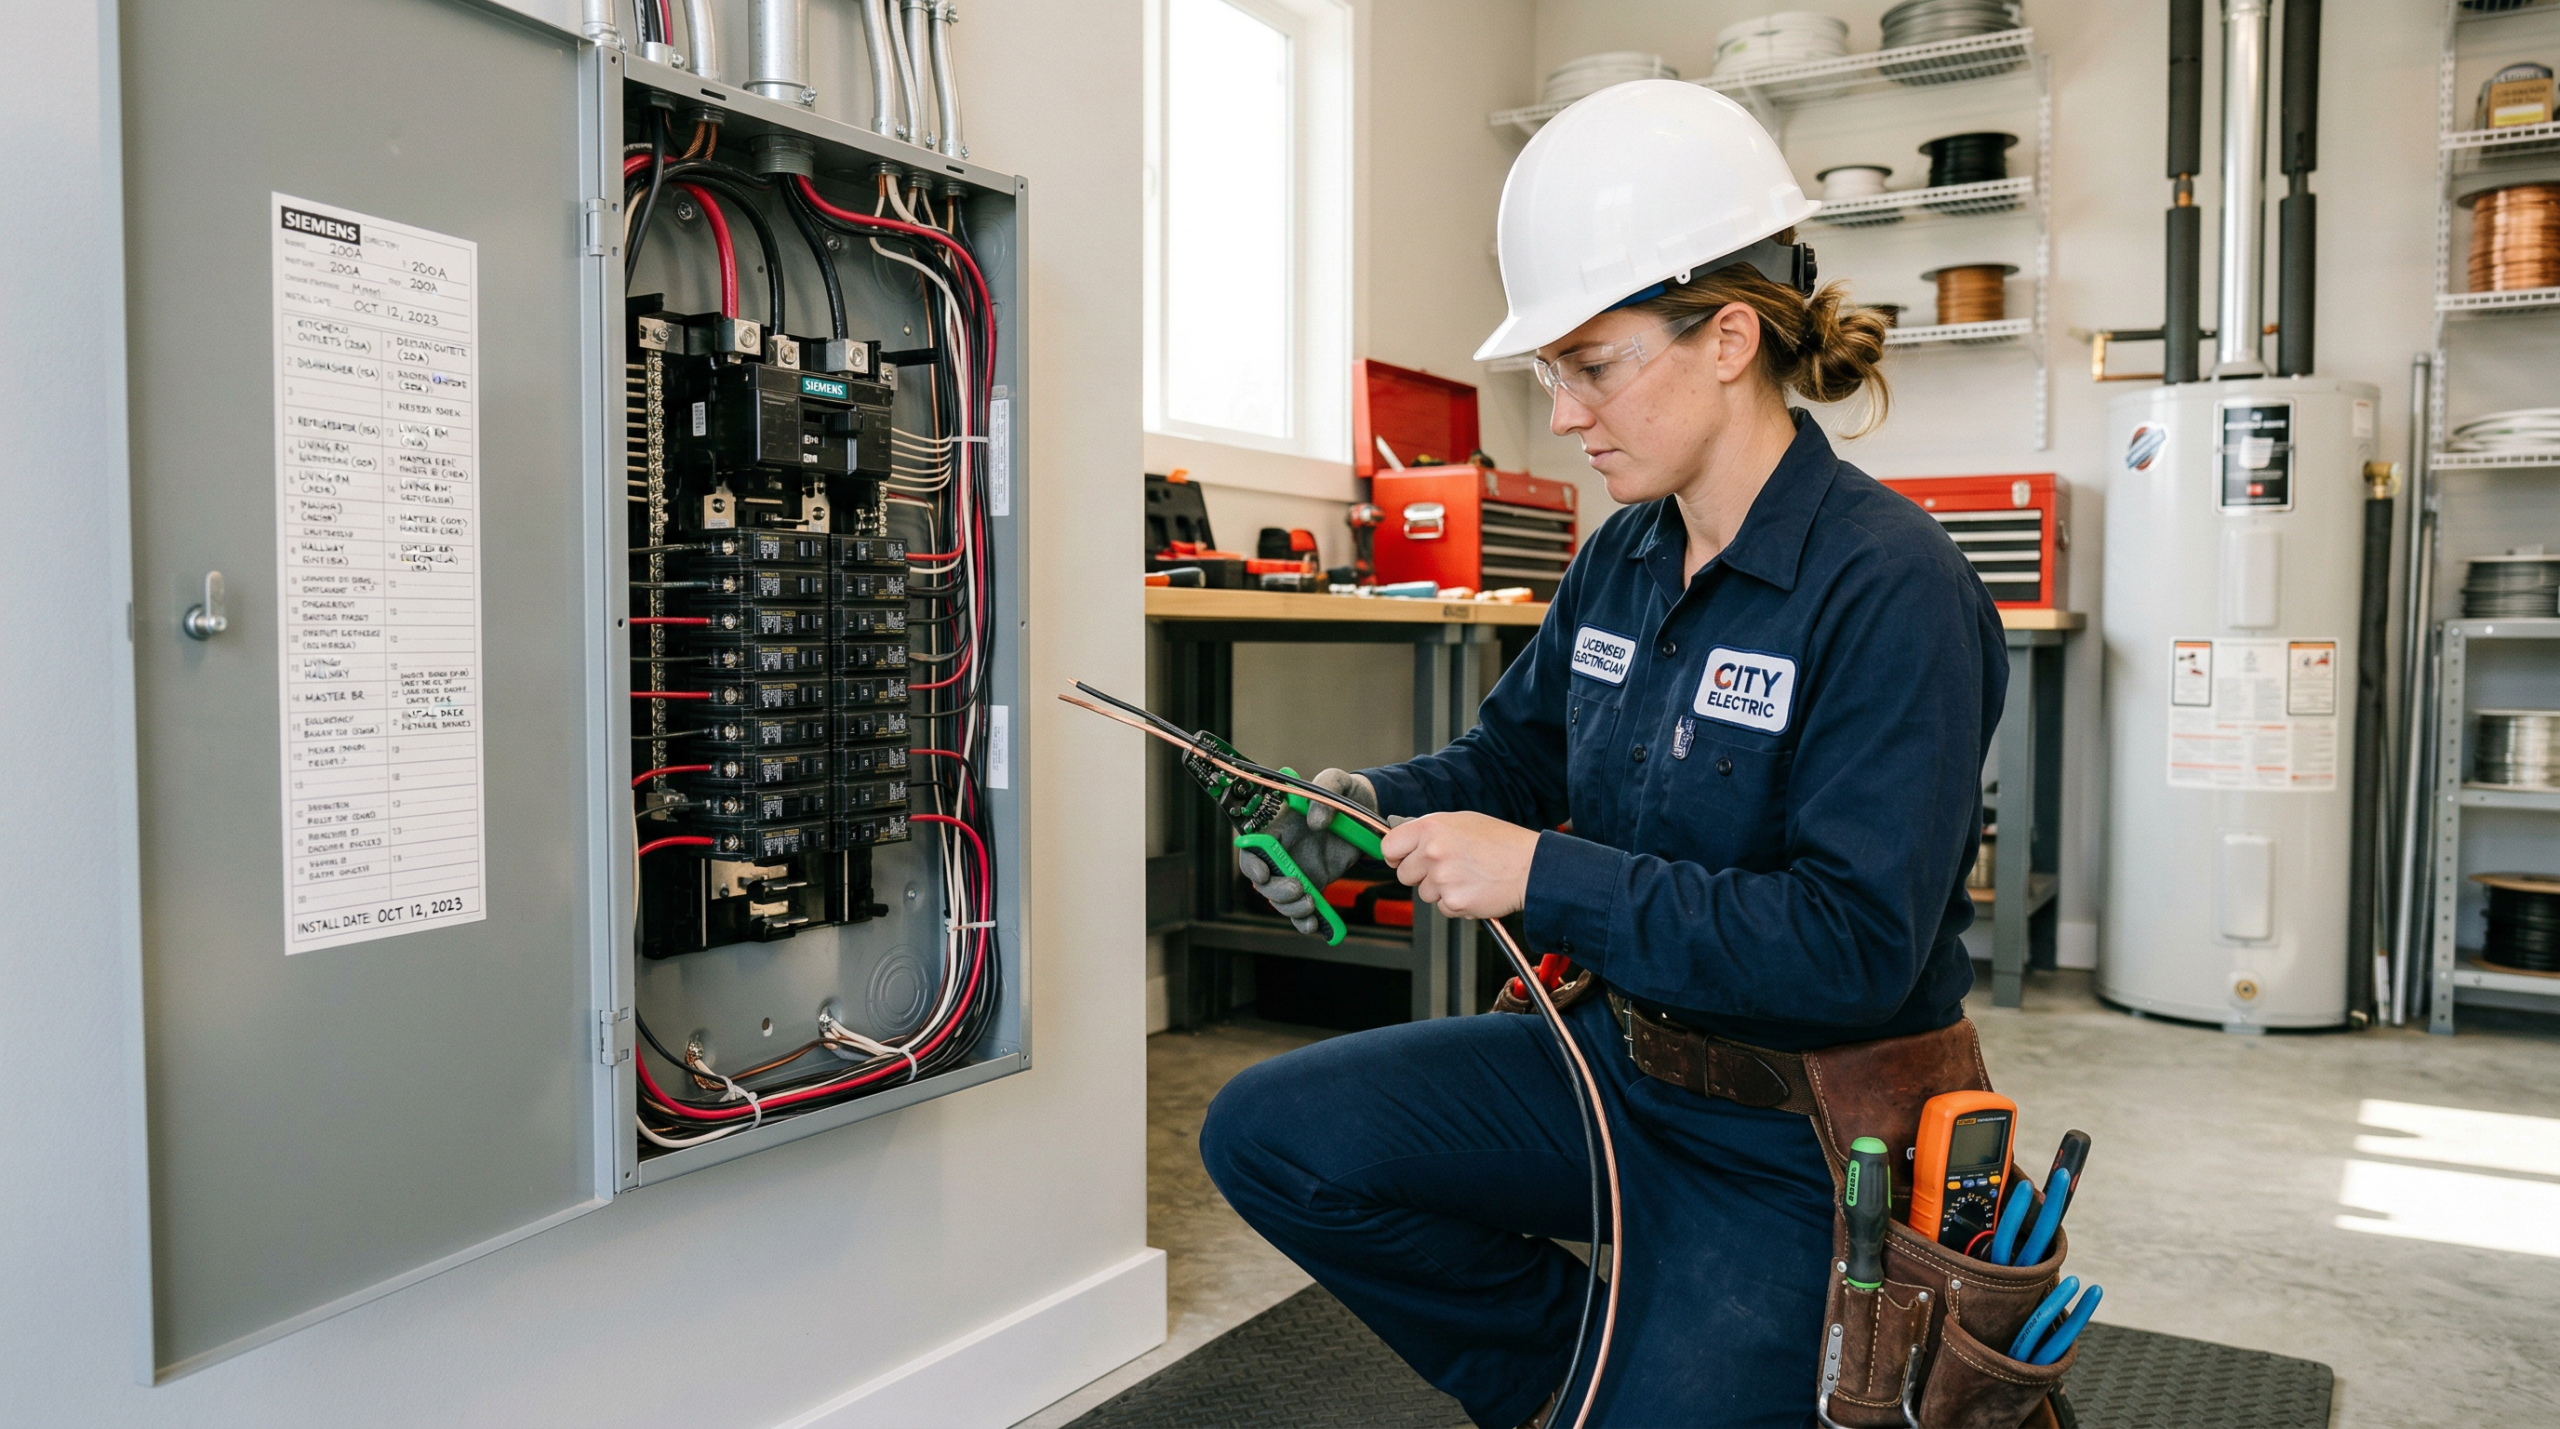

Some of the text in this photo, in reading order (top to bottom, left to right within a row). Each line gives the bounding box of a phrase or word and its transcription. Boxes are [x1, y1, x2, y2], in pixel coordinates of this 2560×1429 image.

[285, 211, 358, 242] SIEMENS
[330, 243, 362, 259] 200A
[330, 261, 361, 277] 200A
[411, 261, 447, 281] 200A
[410, 278, 438, 293] 200A
[353, 300, 379, 313] OCT
[387, 305, 404, 321] 12,
[408, 310, 439, 326] 2023
[805, 380, 843, 395] SIEMENS
[1582, 636, 1627, 660] LICENSED
[1714, 662, 1783, 698] CITY
[305, 692, 346, 704] MASTER
[1707, 690, 1775, 718] ELECTRIC
[297, 896, 463, 935] INSTALL DATE OCT 12, 2023
